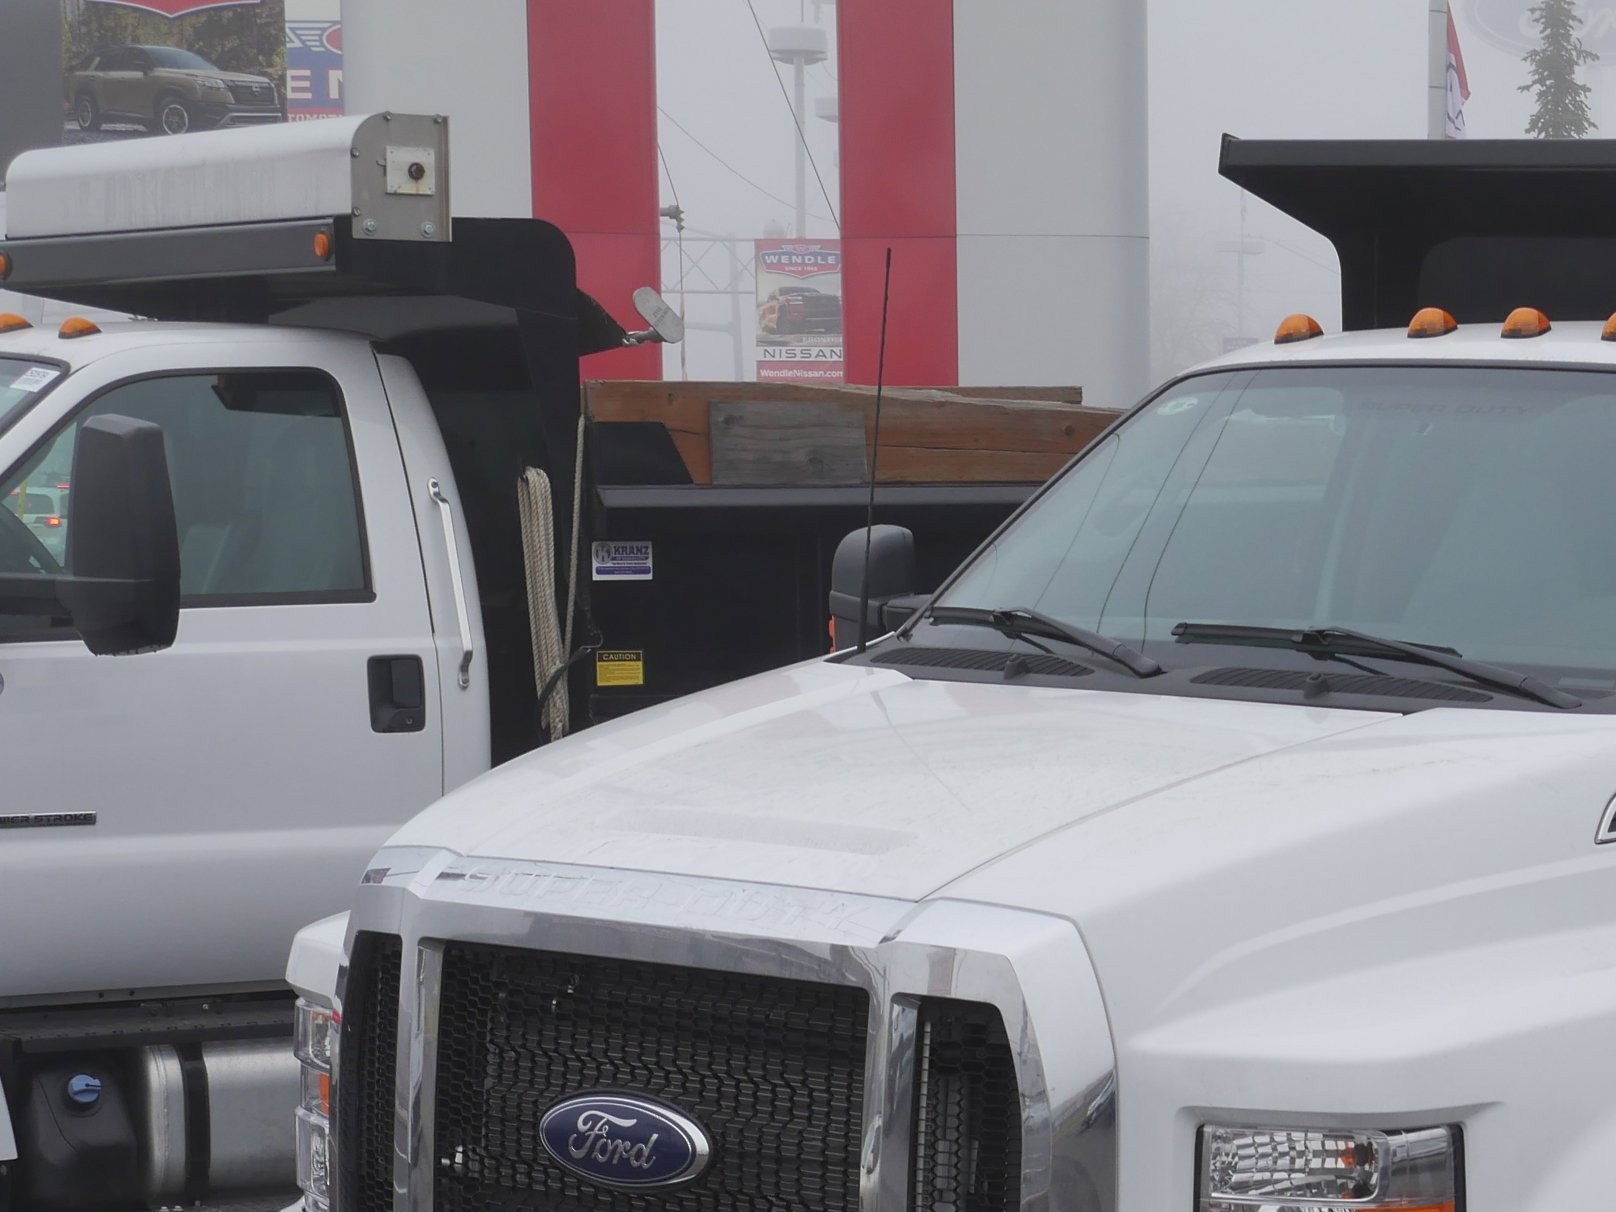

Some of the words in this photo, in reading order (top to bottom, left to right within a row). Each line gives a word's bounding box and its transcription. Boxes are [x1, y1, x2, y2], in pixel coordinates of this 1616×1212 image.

[765, 255, 837, 264] WENDLE
[763, 348, 842, 359] NISSAN
[613, 545, 649, 556] KRANZ
[602, 653, 636, 661] CAUTION
[34, 813, 94, 824] STROKE
[568, 1110, 657, 1169] Ford
